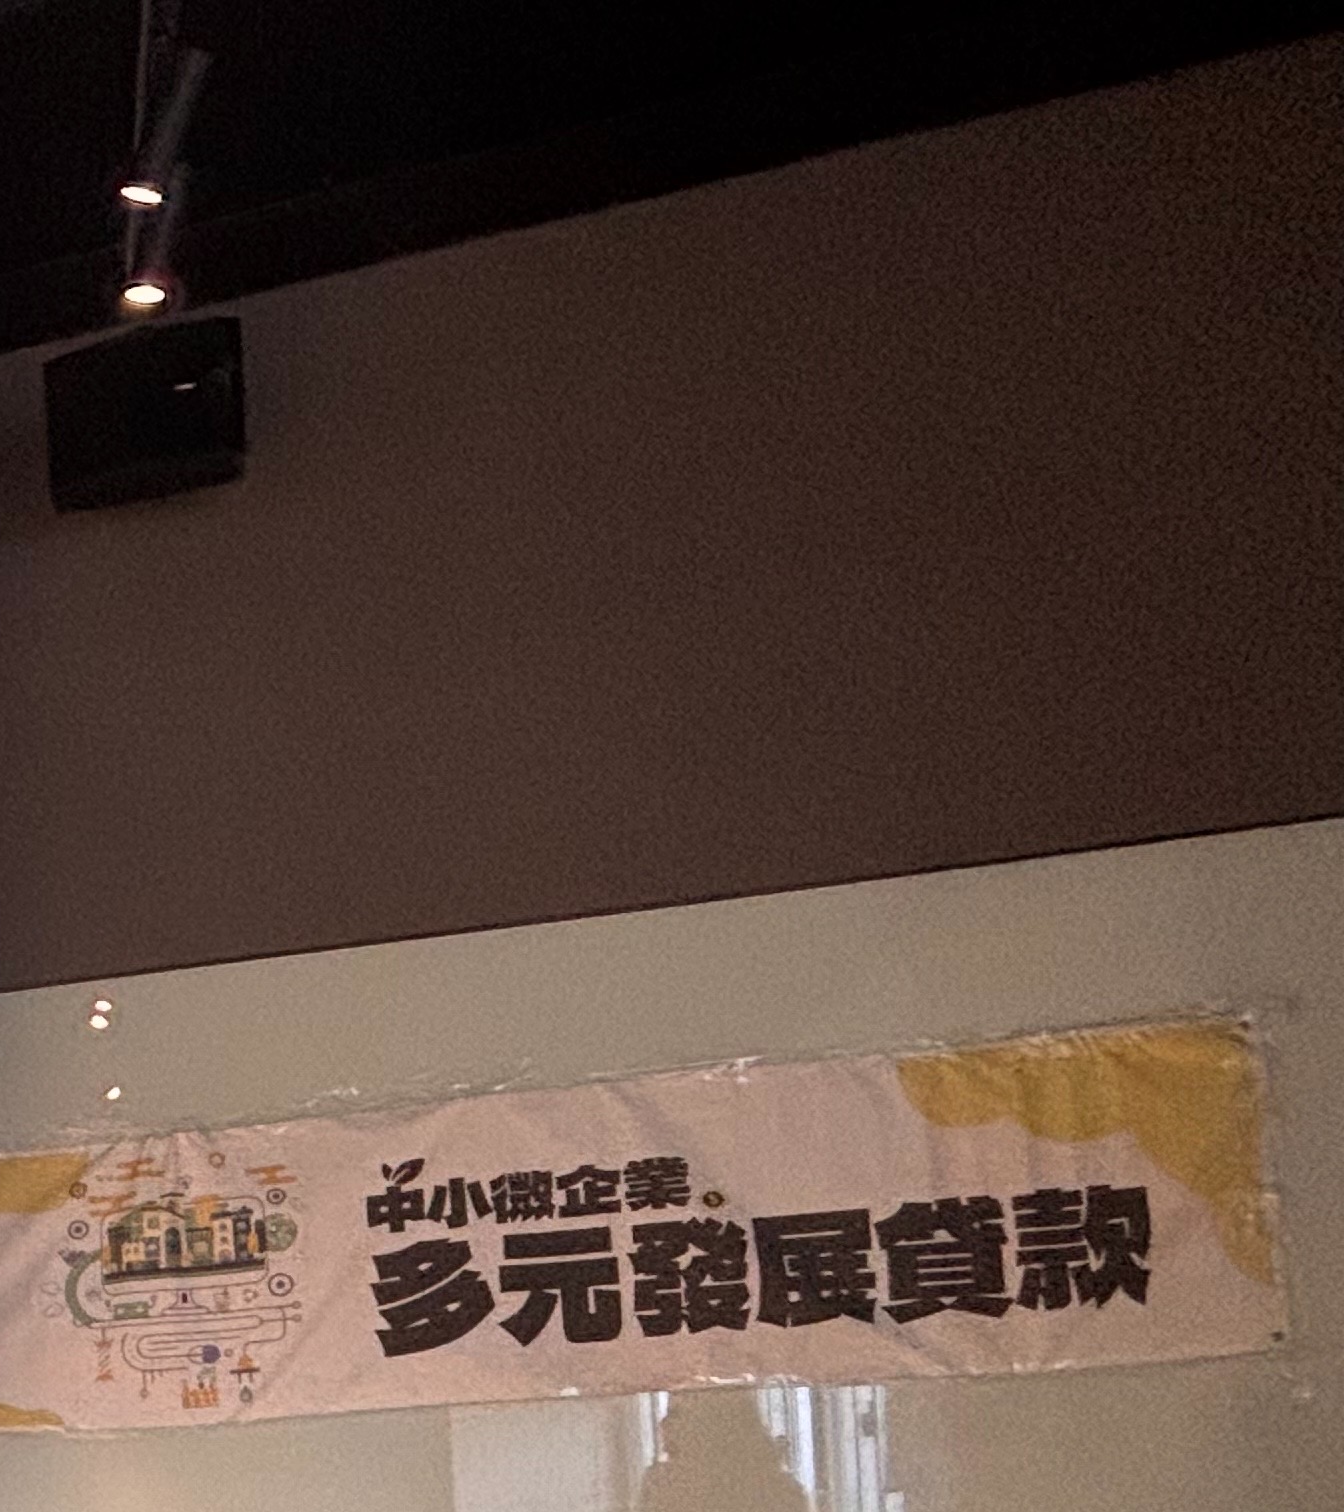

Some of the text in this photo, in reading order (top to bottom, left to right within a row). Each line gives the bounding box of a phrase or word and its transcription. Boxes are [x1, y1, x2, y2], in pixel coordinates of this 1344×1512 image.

[366, 1157, 693, 1234] 中小微企業
[369, 1185, 1152, 1357] 多元發展貸款
